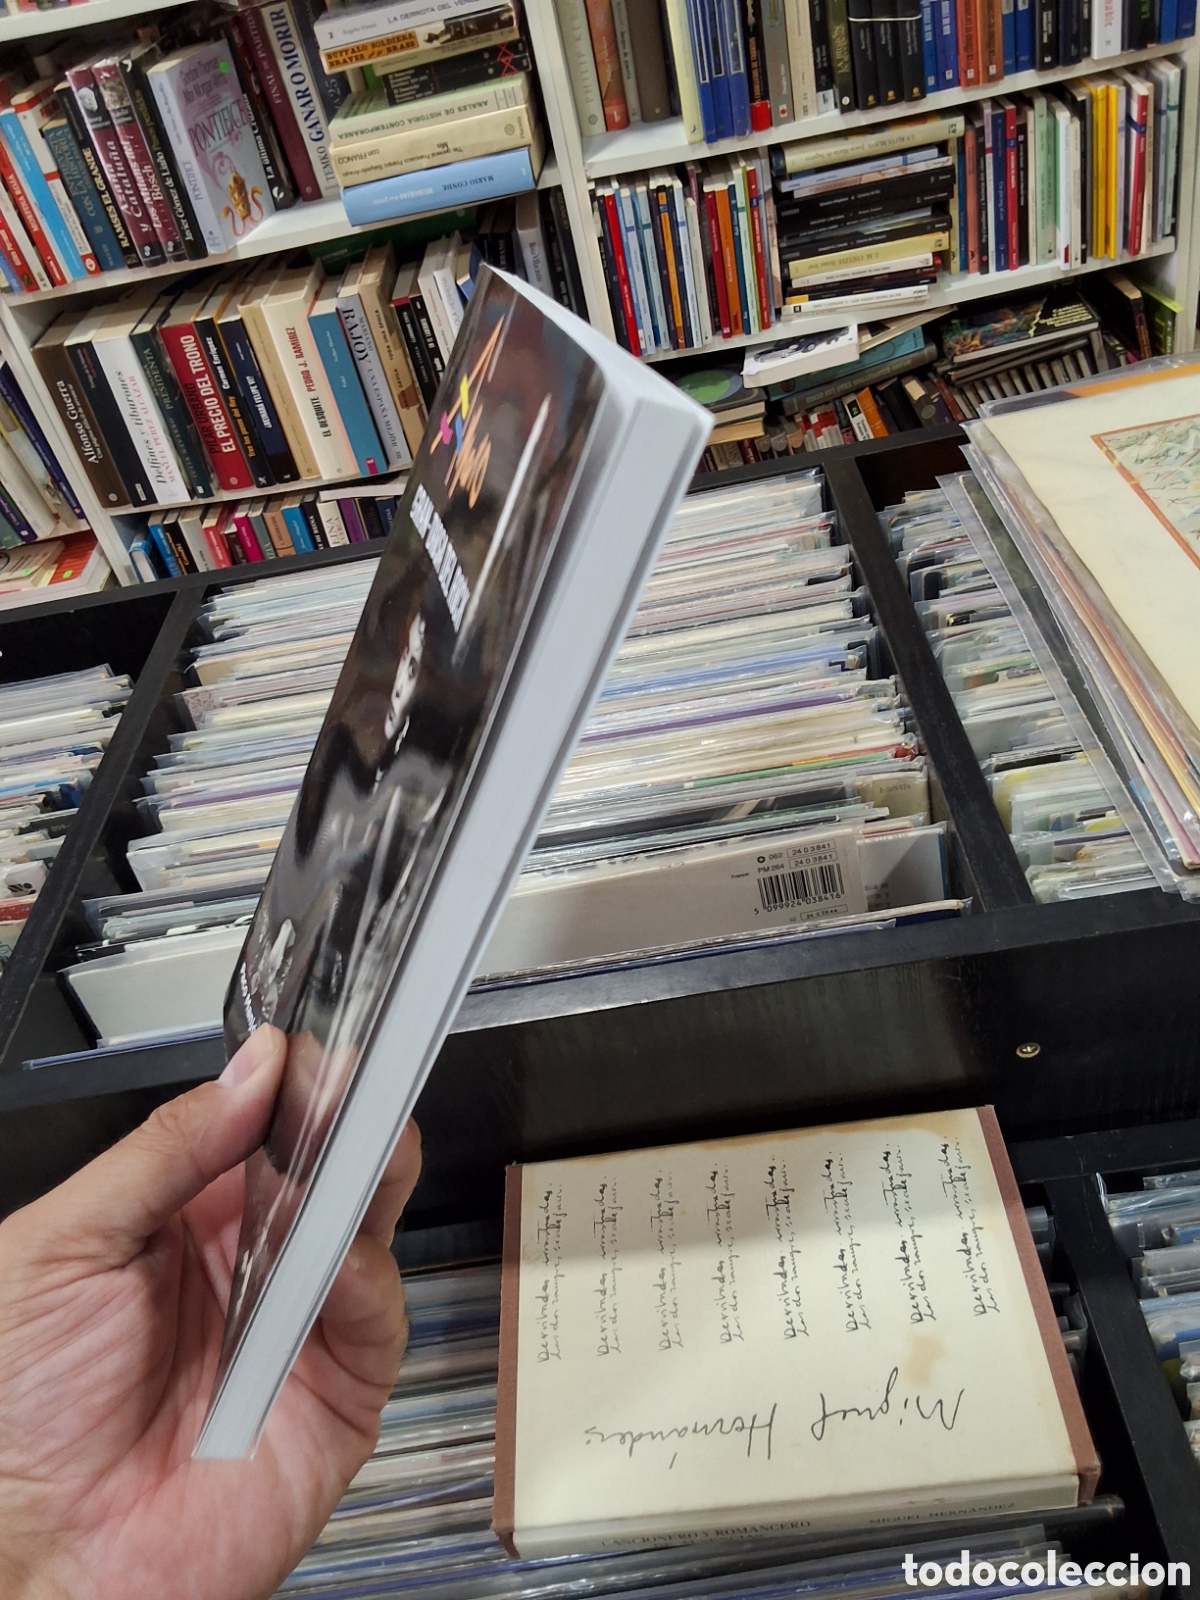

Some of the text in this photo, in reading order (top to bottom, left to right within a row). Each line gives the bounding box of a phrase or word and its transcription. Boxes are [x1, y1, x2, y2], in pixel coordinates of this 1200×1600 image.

[244, 10, 265, 56] PARTIDA
[327, 44, 366, 58] BUFFALO
[329, 40, 414, 66] BRAVES BRASS
[266, 72, 281, 103] FINAL
[270, 10, 334, 180] TEMKO GANAR O MORIR
[408, 111, 440, 123] HISTORIA
[457, 100, 487, 111] ANALES
[339, 121, 403, 138] CONTEMPORANEA
[122, 139, 135, 160] del
[338, 148, 379, 163] con FRANCO
[7, 174, 21, 195] ROJA
[105, 140, 141, 217] Cataluña
[143, 164, 162, 200] Bosch
[163, 176, 173, 188] de
[265, 165, 274, 179] La
[442, 180, 467, 190] CONDE
[469, 175, 493, 184] MARIO
[83, 148, 128, 246] RAMSES EL GRANDE
[167, 188, 184, 218] Gómez
[18, 196, 38, 231] MORFINA
[148, 206, 161, 228] Los
[179, 218, 193, 241] Javier
[284, 325, 304, 359] RAMÍREZ
[342, 308, 370, 364] RAJOY
[359, 317, 372, 350] MARIANO
[204, 336, 221, 365] Enríquez
[144, 348, 172, 408] PRESIDENTA
[216, 365, 230, 389] Carmen
[300, 368, 316, 393] PEDRO
[115, 371, 140, 426] tiburones
[180, 333, 235, 453] EL PRECIO DEL TRONO
[55, 380, 97, 465] Alfonso Guerra
[185, 381, 220, 454] PILAR URBANO
[309, 395, 329, 428] DESQUITE
[321, 427, 331, 438] EL
[142, 439, 166, 483] Delfines
[168, 417, 197, 478] JULIA NAVARRO
[246, 444, 255, 457] Tras
[446, 565, 470, 633] ROCK
[769, 852, 783, 861] 062
[766, 900, 802, 913] 099924
[806, 893, 841, 905] 038416
[811, 1367, 964, 1441] Miguel
[604, 1532, 695, 1546] CANCIONERO
[718, 1521, 808, 1535] ROMANCERO
